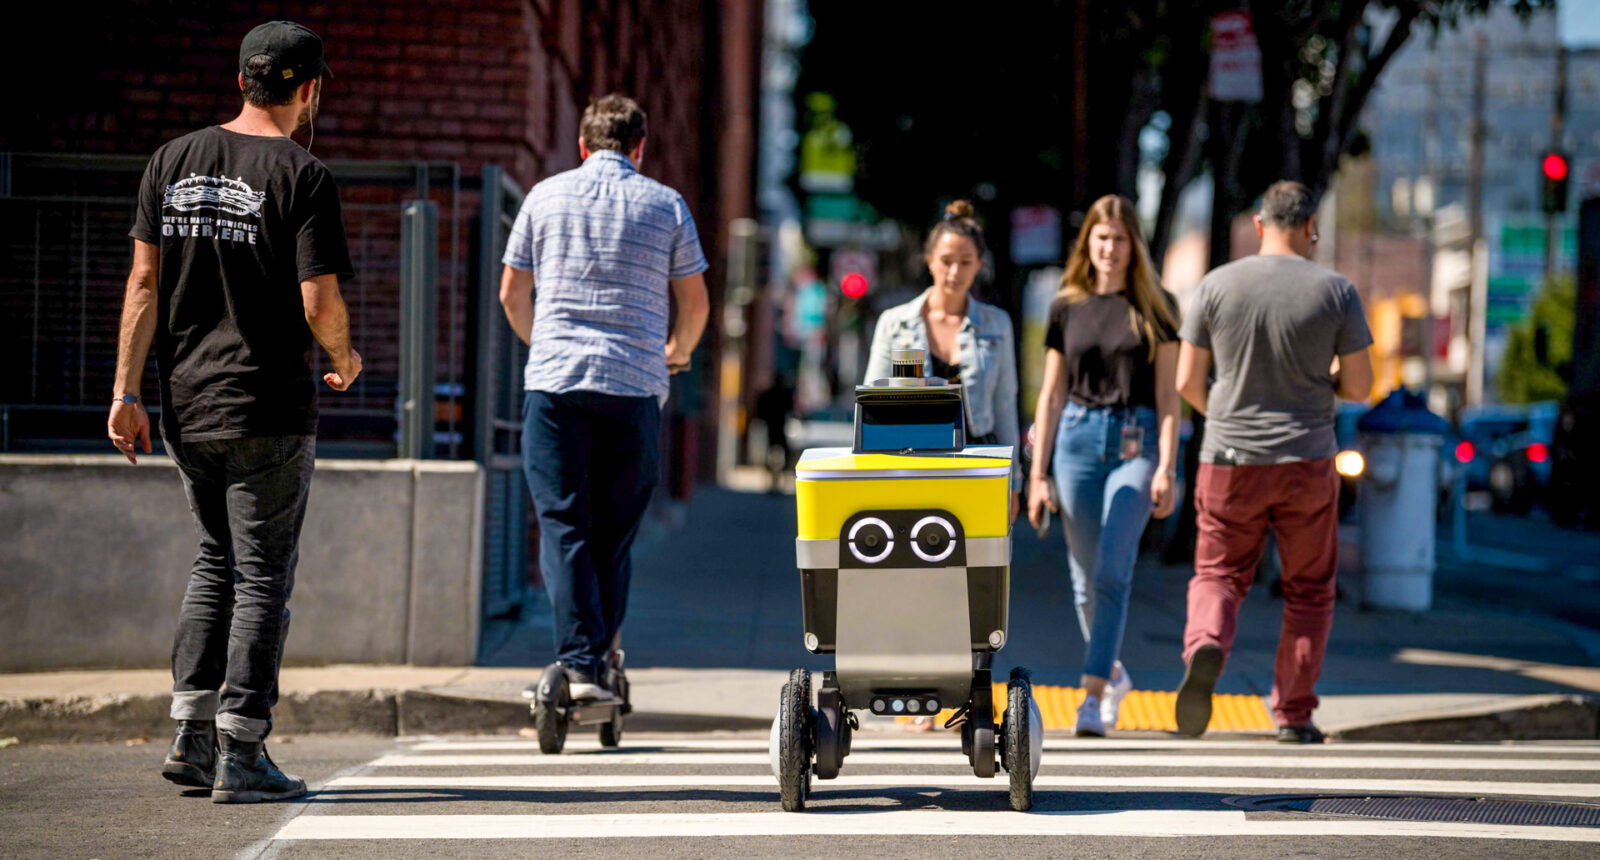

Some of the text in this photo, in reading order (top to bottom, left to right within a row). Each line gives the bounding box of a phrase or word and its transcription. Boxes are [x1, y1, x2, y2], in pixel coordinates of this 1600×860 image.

[162, 216, 188, 224] WE'RE
[162, 224, 257, 245] OVER ERE
